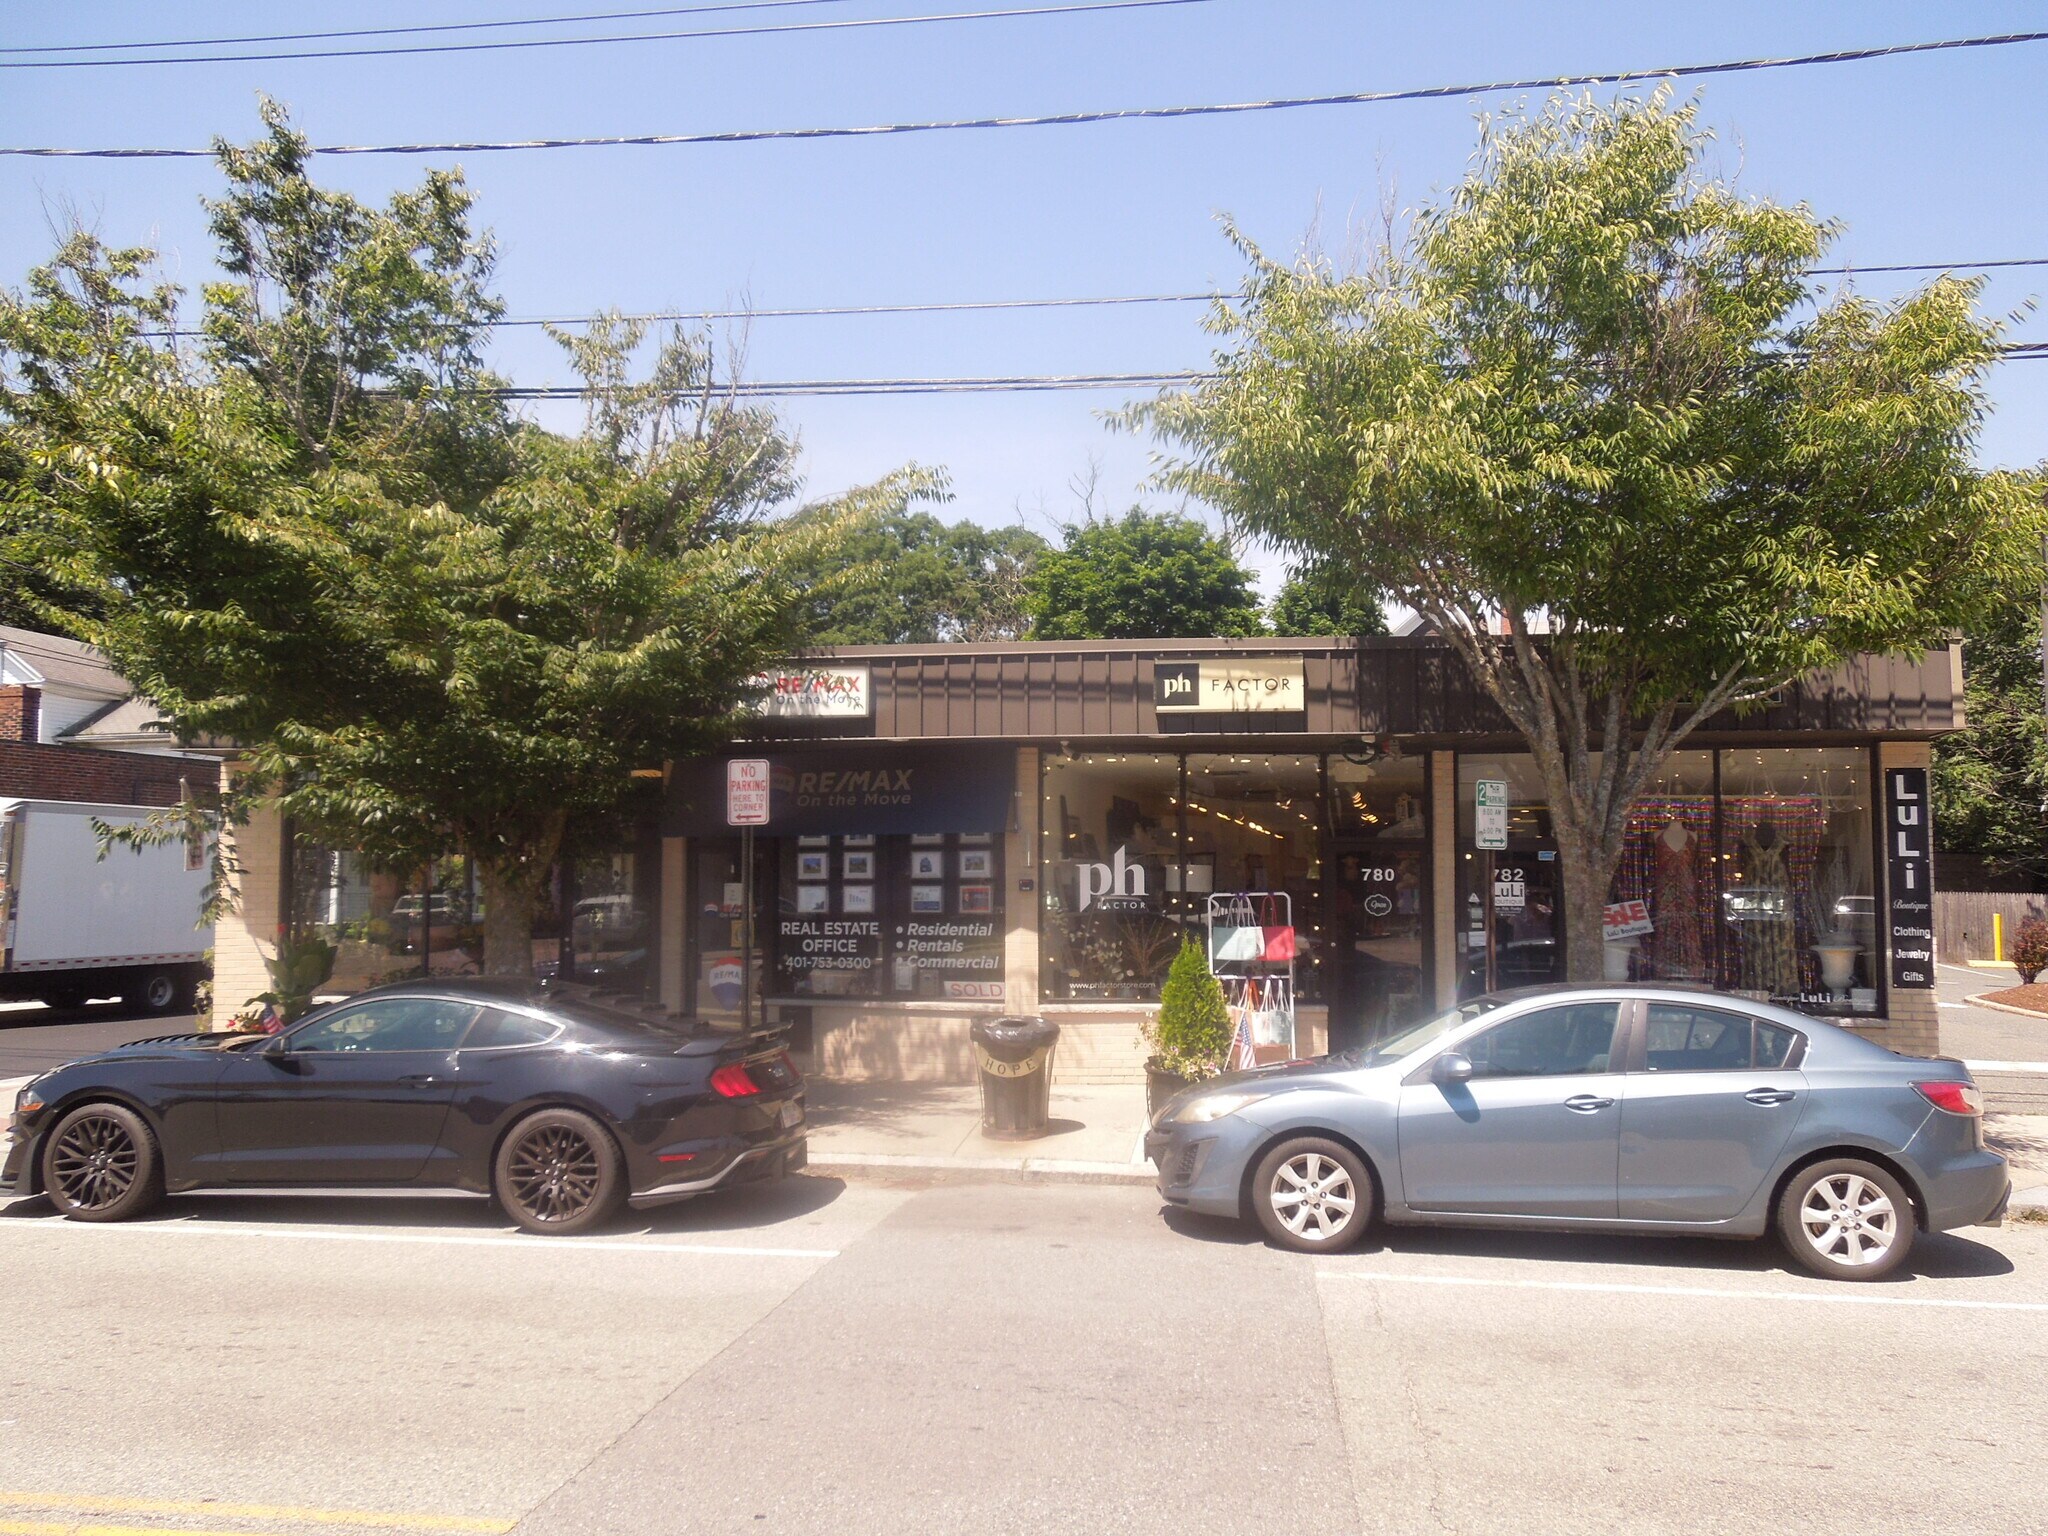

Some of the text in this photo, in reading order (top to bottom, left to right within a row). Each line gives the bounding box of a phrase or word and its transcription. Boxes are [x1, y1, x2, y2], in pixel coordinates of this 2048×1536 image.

[1164, 672, 1290, 699] ph FACTOR
[776, 695, 793, 705] On
[800, 695, 819, 705] the
[741, 766, 756, 778] NO
[730, 780, 766, 792] PARKING
[800, 769, 914, 793] RE/MAX
[733, 793, 764, 802] HERE TO
[1478, 784, 1487, 801] 2
[797, 792, 912, 807] On the Move
[733, 803, 763, 812] CORNER
[1076, 844, 1149, 913] ph
[1361, 868, 1395, 882] 780
[1494, 884, 1523, 897] uLi
[1097, 901, 1146, 910] FACTOR
[1893, 899, 1929, 913] Boutique
[781, 922, 879, 935] REAL ESTATE
[907, 923, 993, 936] Residential
[1893, 926, 1931, 939] Clothing
[802, 939, 857, 952] OFFICE
[907, 939, 964, 952] Rentals
[1896, 949, 1930, 961] Jewelry
[785, 957, 871, 969] 401-753-0300
[907, 956, 999, 969] Commercial
[714, 970, 742, 979] RE/MA
[1902, 971, 1924, 982] Gifts
[950, 984, 1003, 997] SOLD
[1801, 992, 1831, 1003] LuLi
[984, 1058, 1036, 1076] HOPE
